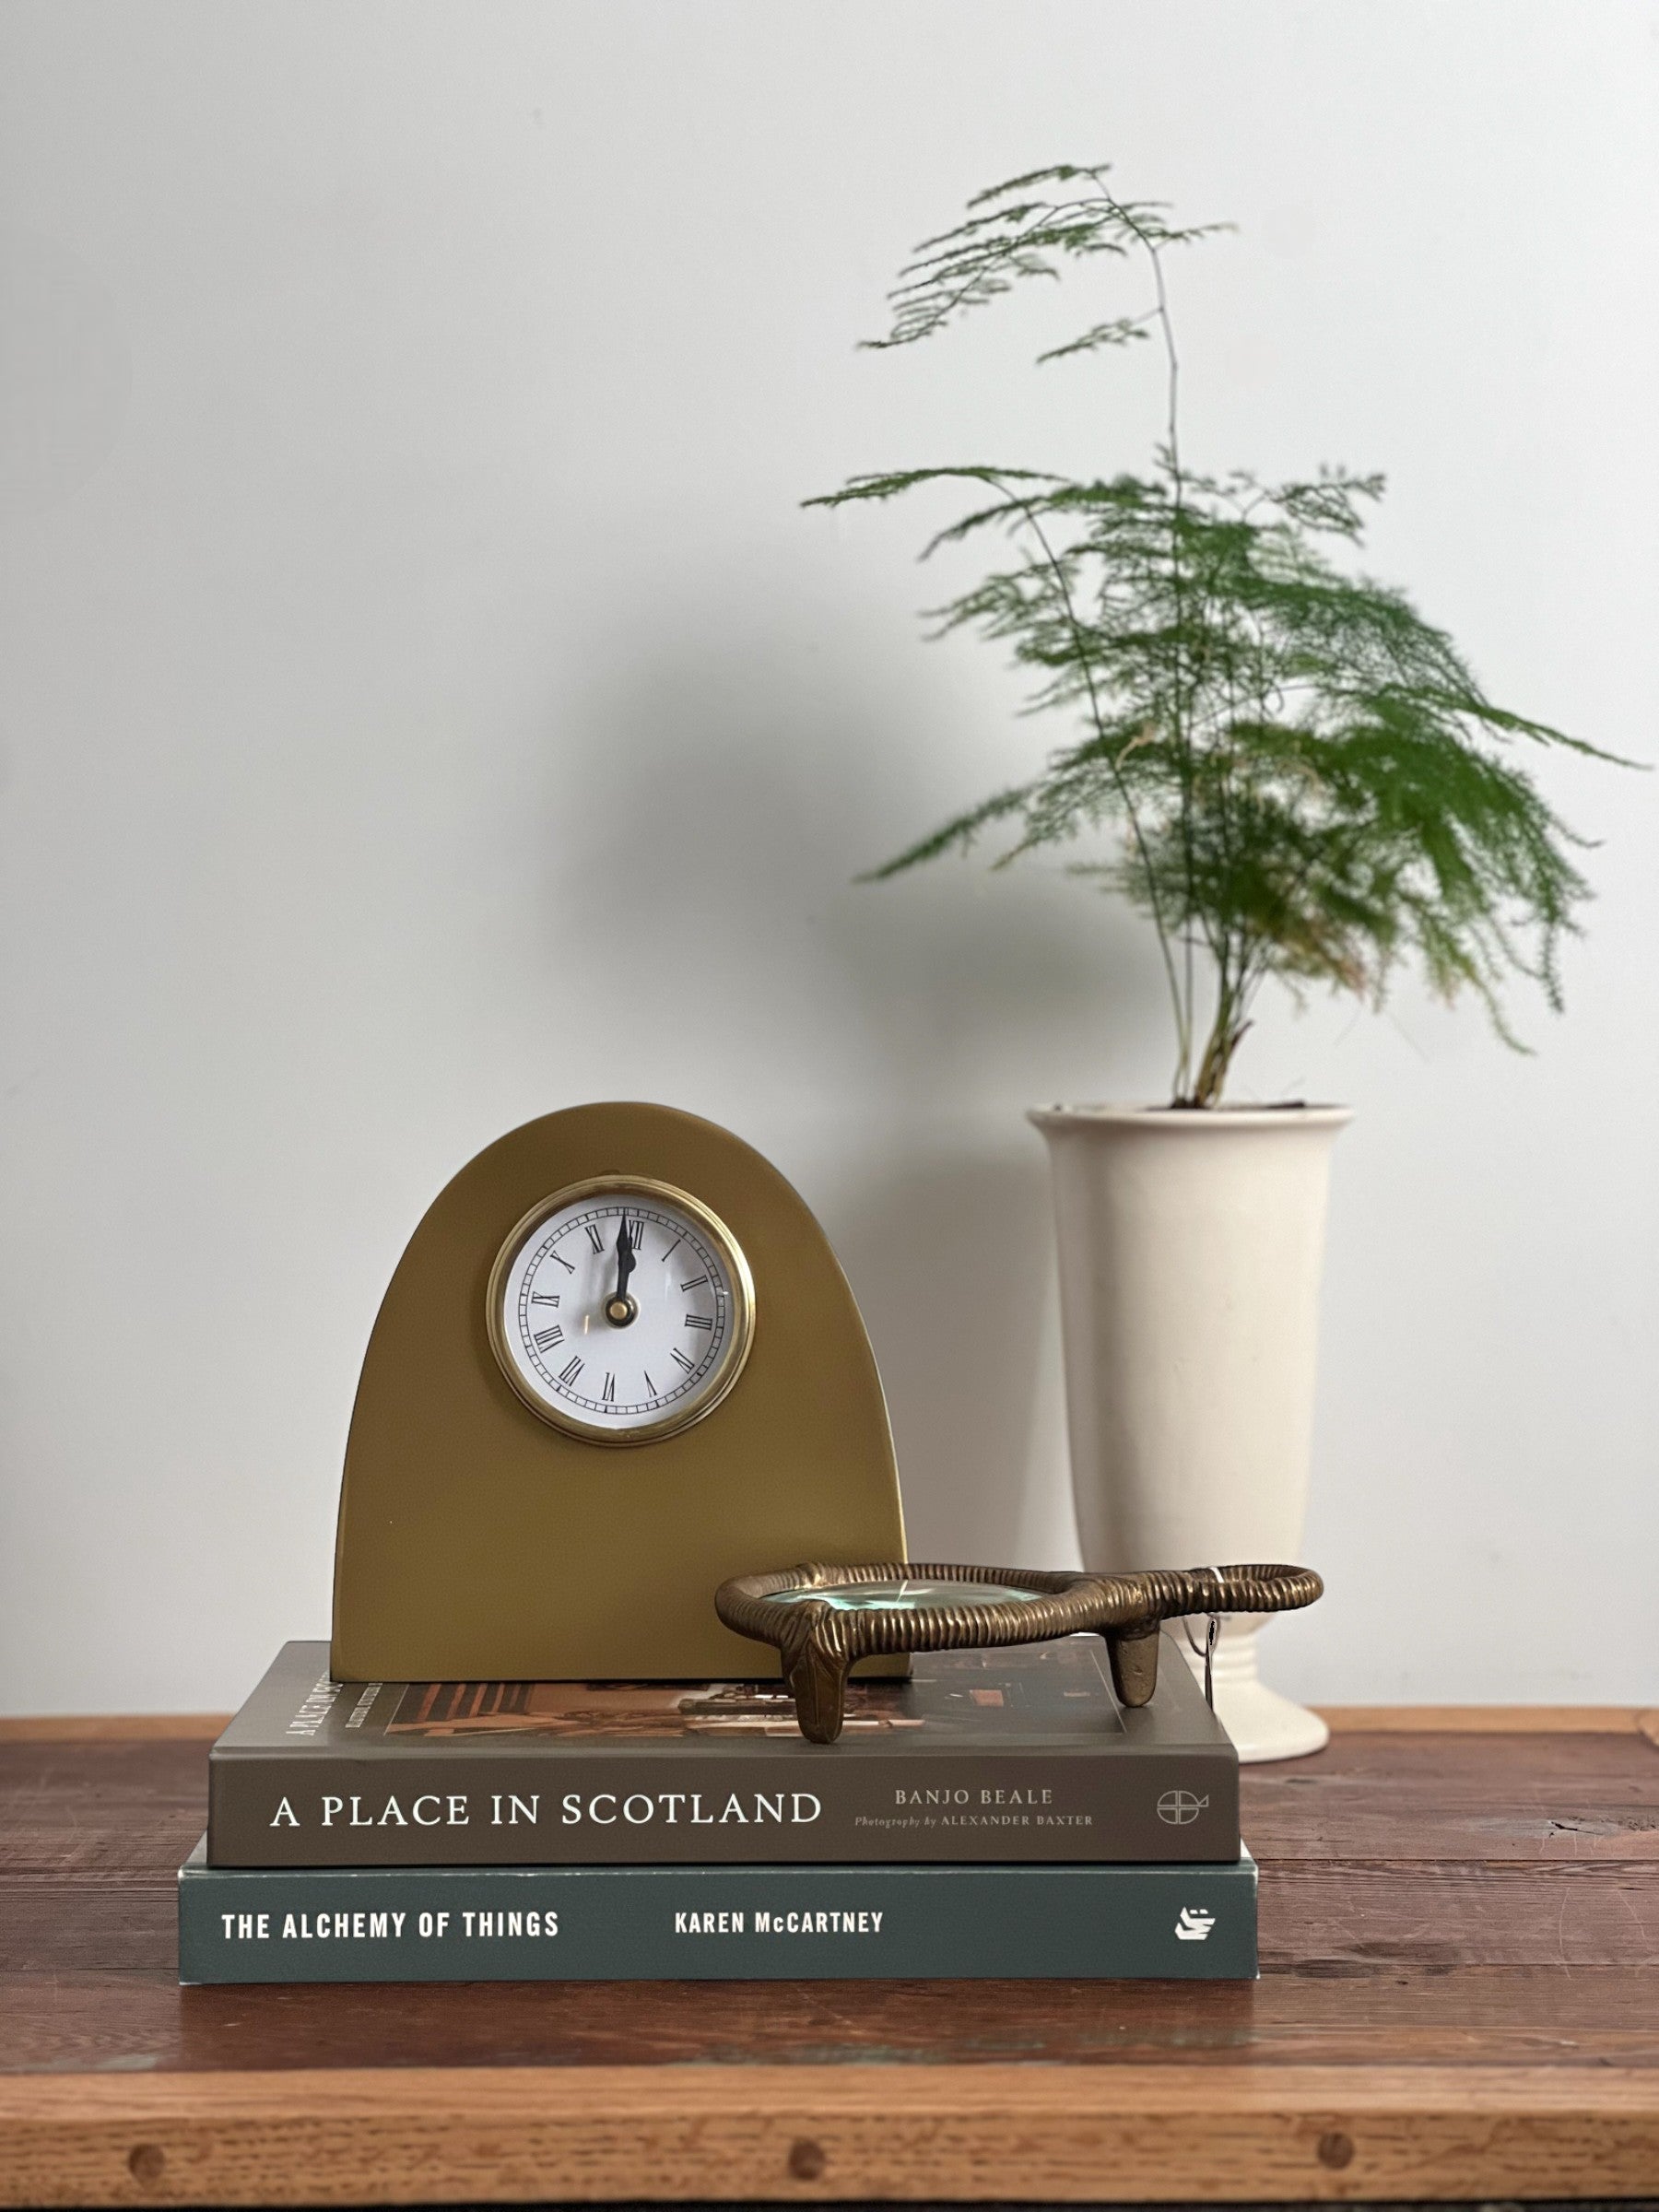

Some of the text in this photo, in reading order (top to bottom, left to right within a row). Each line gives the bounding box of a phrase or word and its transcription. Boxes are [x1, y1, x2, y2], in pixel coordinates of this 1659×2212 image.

[583, 1223, 605, 1254] XI
[662, 1239, 681, 1262] I
[549, 1250, 575, 1274] X
[680, 1275, 709, 1292] II
[531, 1291, 560, 1308] IX
[684, 1313, 713, 1331] III
[533, 1324, 565, 1354] VIII
[559, 1355, 585, 1386] VII
[670, 1347, 695, 1374] IV
[601, 1371, 616, 1403] VI
[644, 1370, 658, 1398] V
[895, 1789, 1053, 1805] BANJO BEALE
[269, 1793, 821, 1827] A PLACE IN SCOTLAND
[854, 1815, 1093, 1830] Photography by ALEXANDER BAXTER
[221, 1911, 559, 1939] THE ALCHEMY OF THINGS
[675, 1911, 883, 1934] KAREN McCARTNEY
